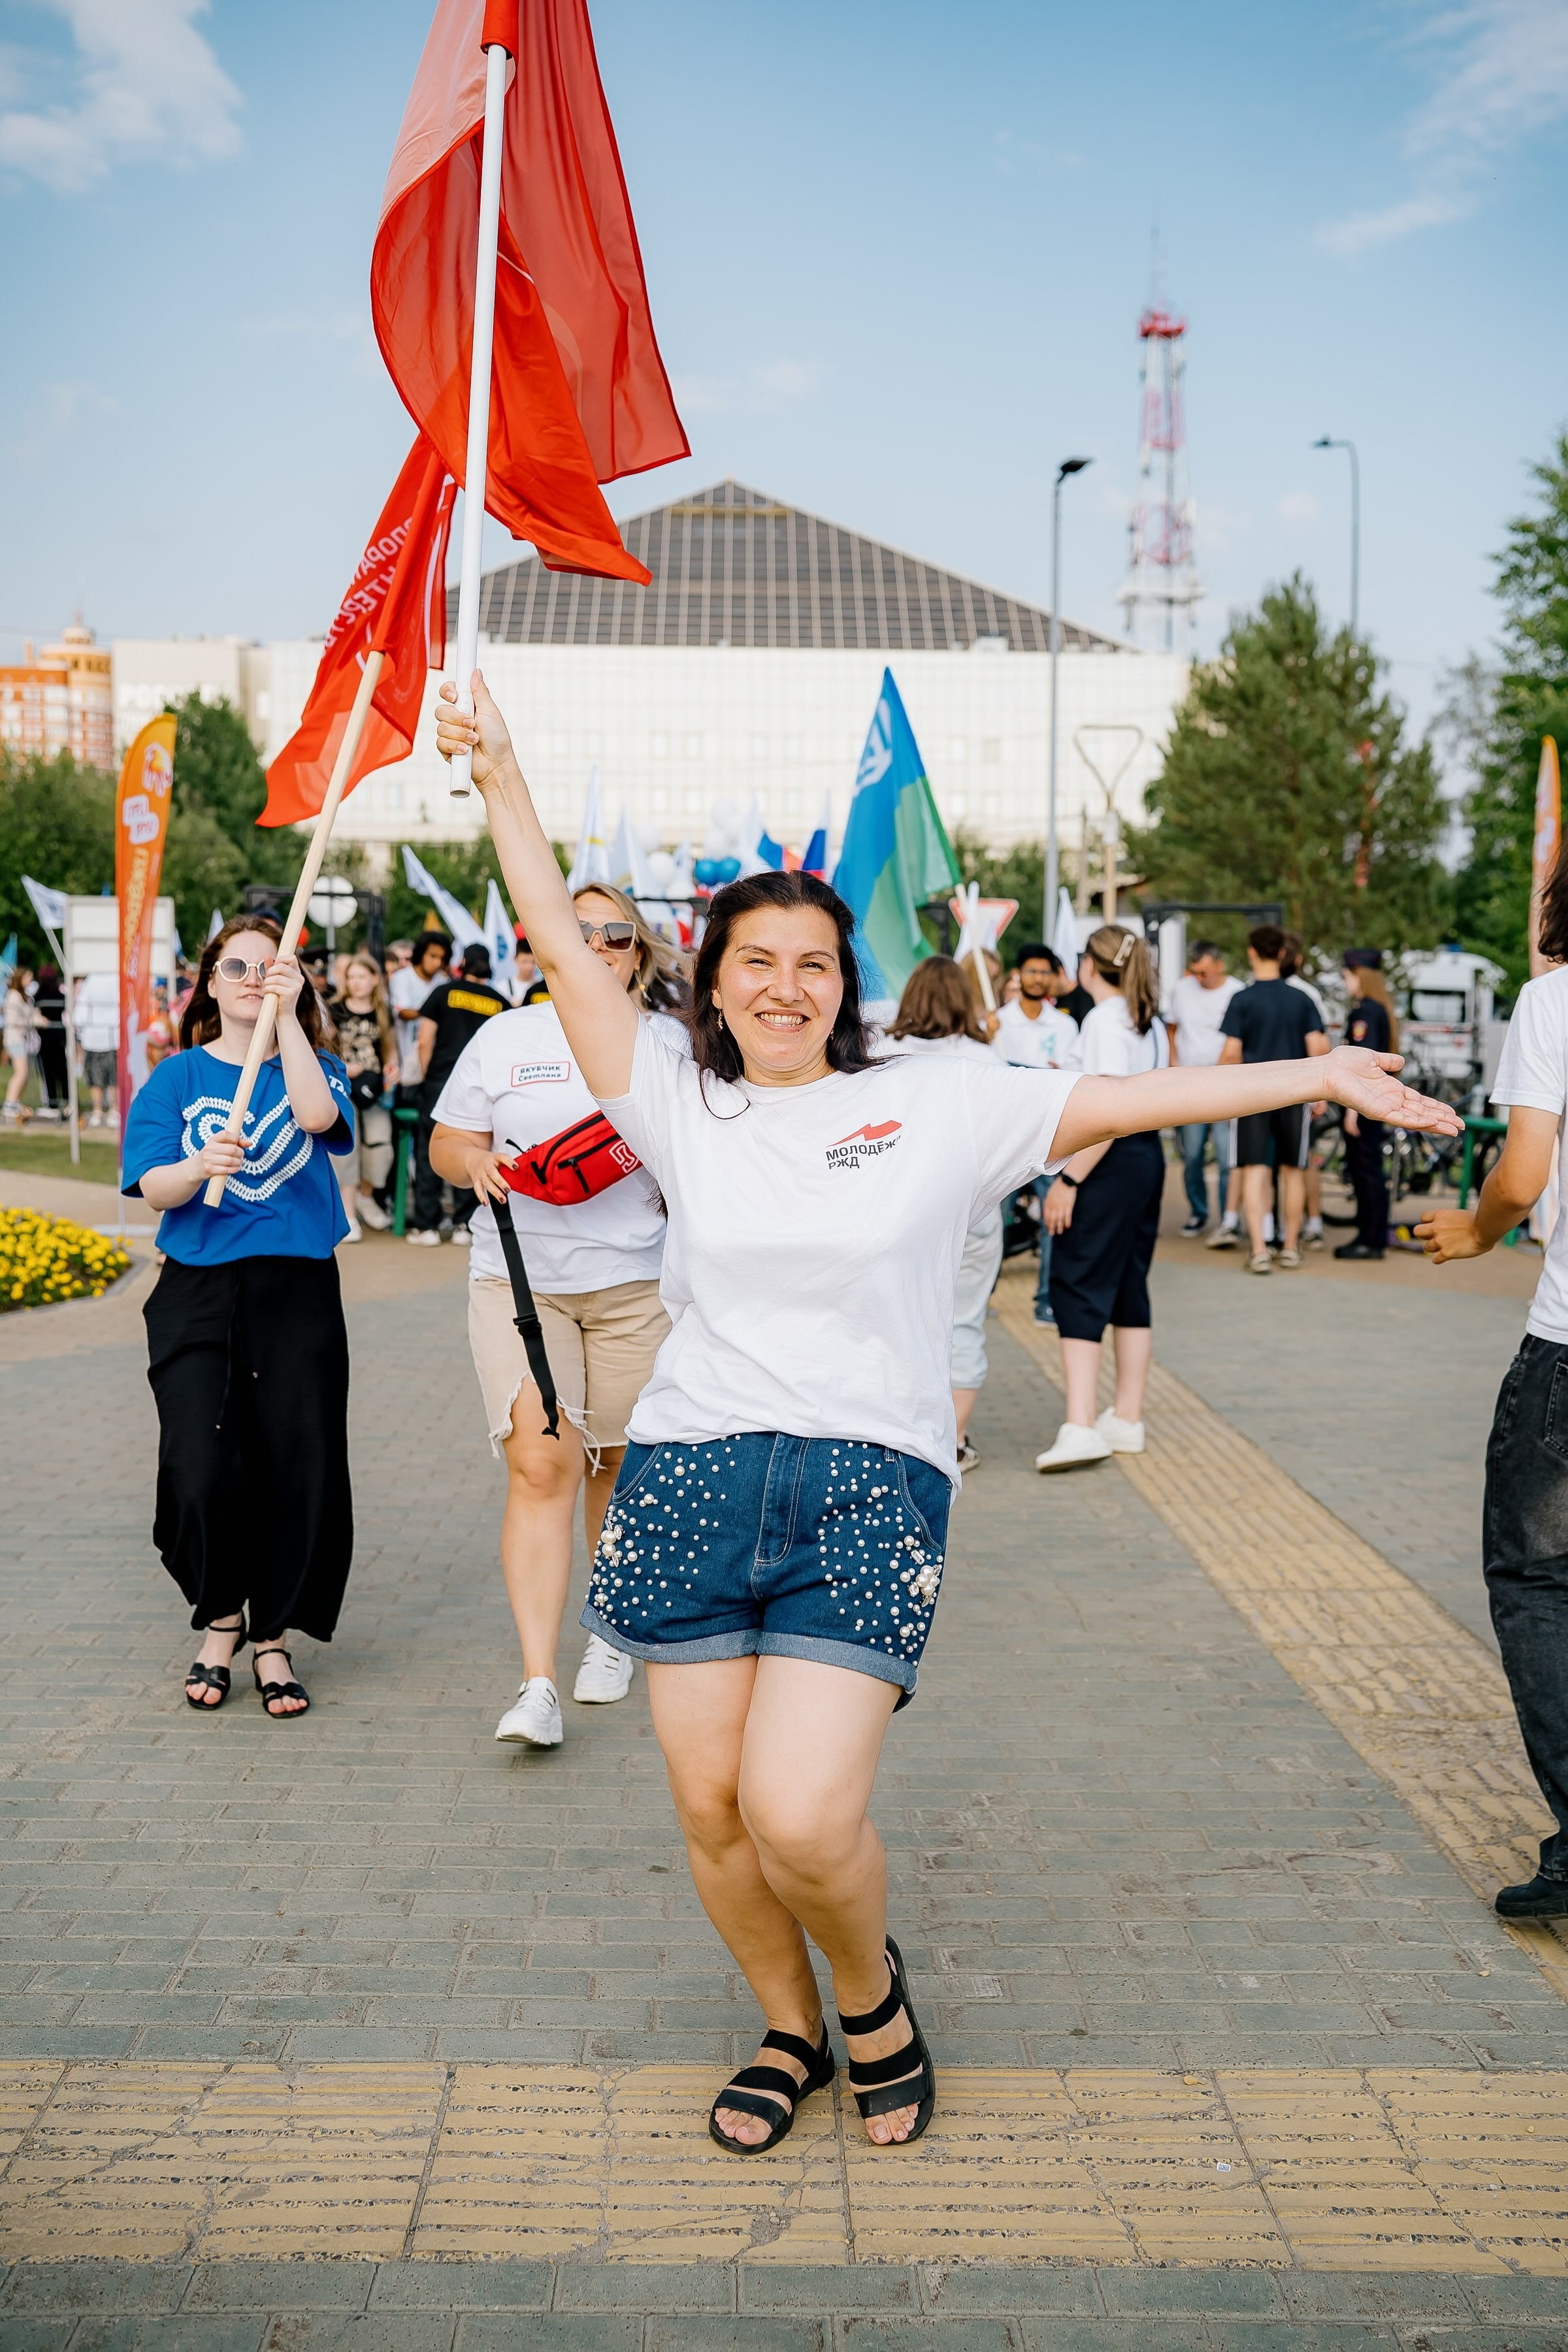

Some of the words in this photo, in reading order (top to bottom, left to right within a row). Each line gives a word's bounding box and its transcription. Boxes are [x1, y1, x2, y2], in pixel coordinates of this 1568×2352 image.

[520, 1065, 561, 1074] ЯКУБЧИК
[518, 1073, 561, 1082] Светлана
[825, 1135, 902, 1161] МОЛОДЁЖ
[828, 1156, 860, 1170] РЖД
